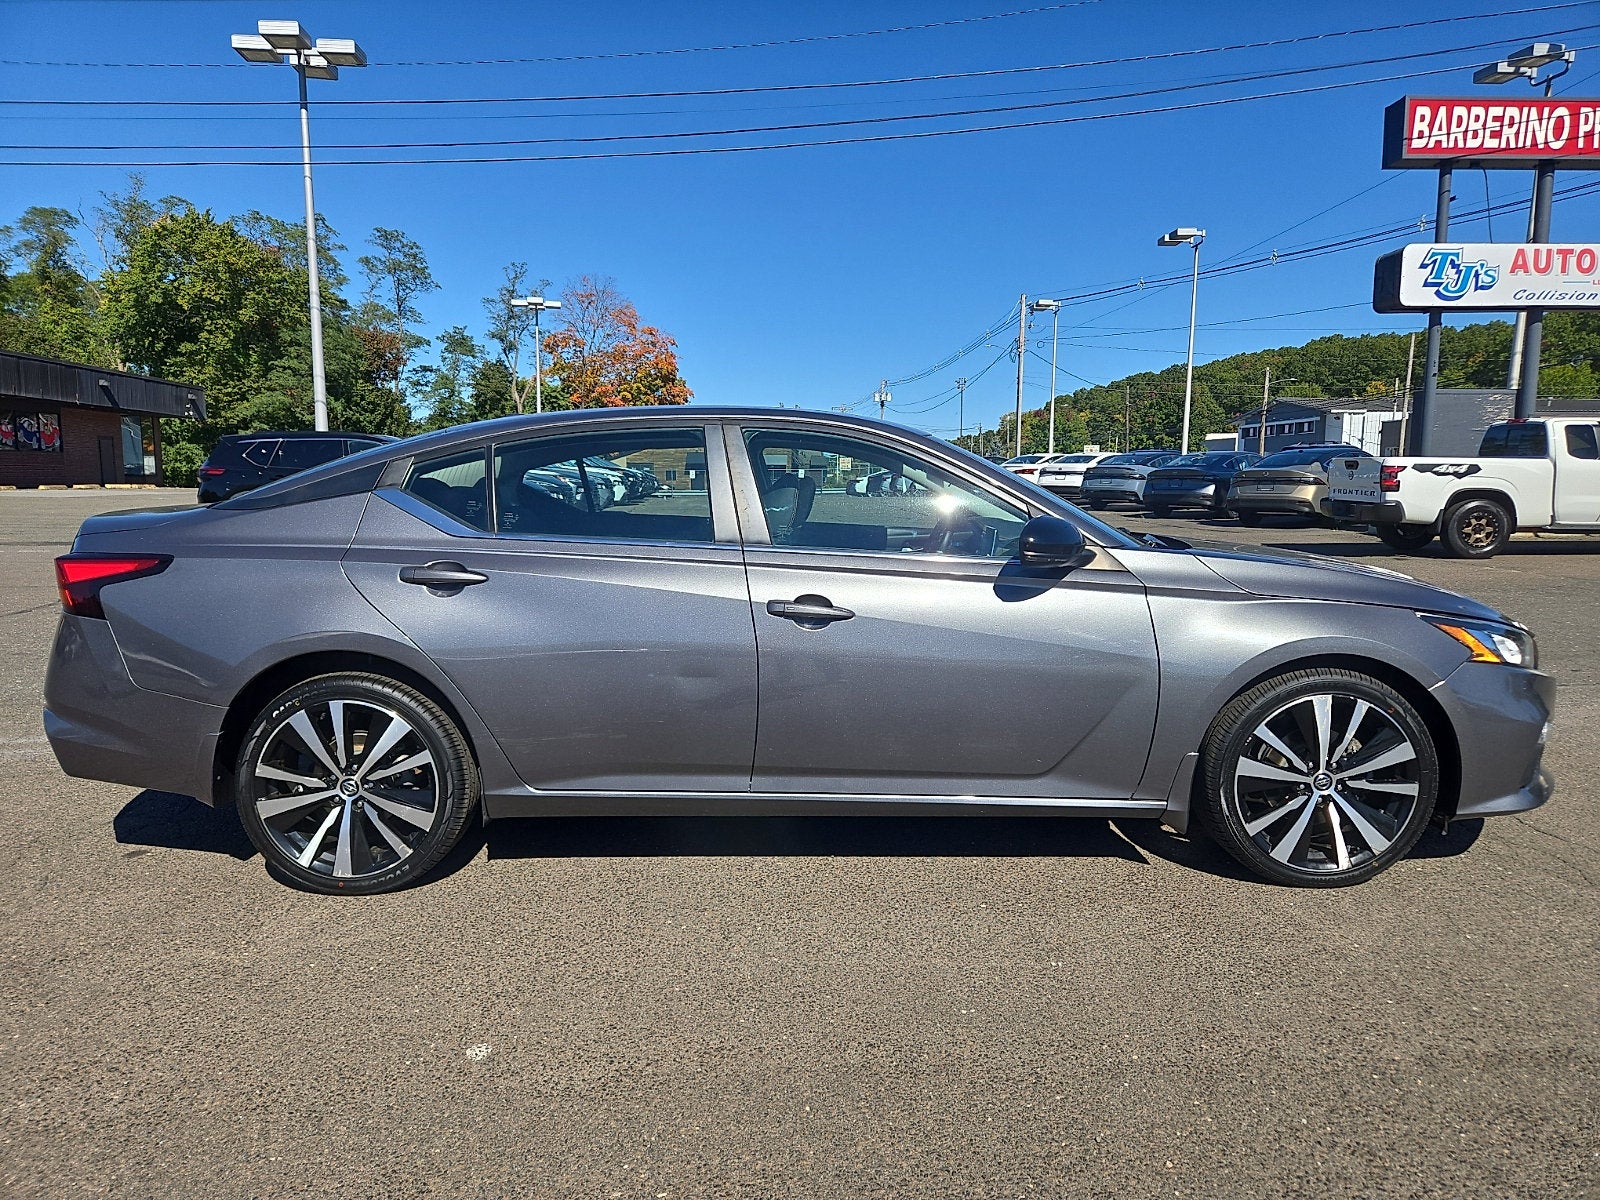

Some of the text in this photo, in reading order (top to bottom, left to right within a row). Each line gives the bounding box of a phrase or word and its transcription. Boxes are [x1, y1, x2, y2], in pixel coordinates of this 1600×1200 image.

[1411, 106, 1570, 149] BARBERINO
[1509, 247, 1598, 276] AUTO
[1418, 247, 1501, 302] TJ's
[1512, 288, 1599, 302] Collision
[1432, 464, 1470, 473] 4x4
[1333, 488, 1376, 497] FRONTIER
